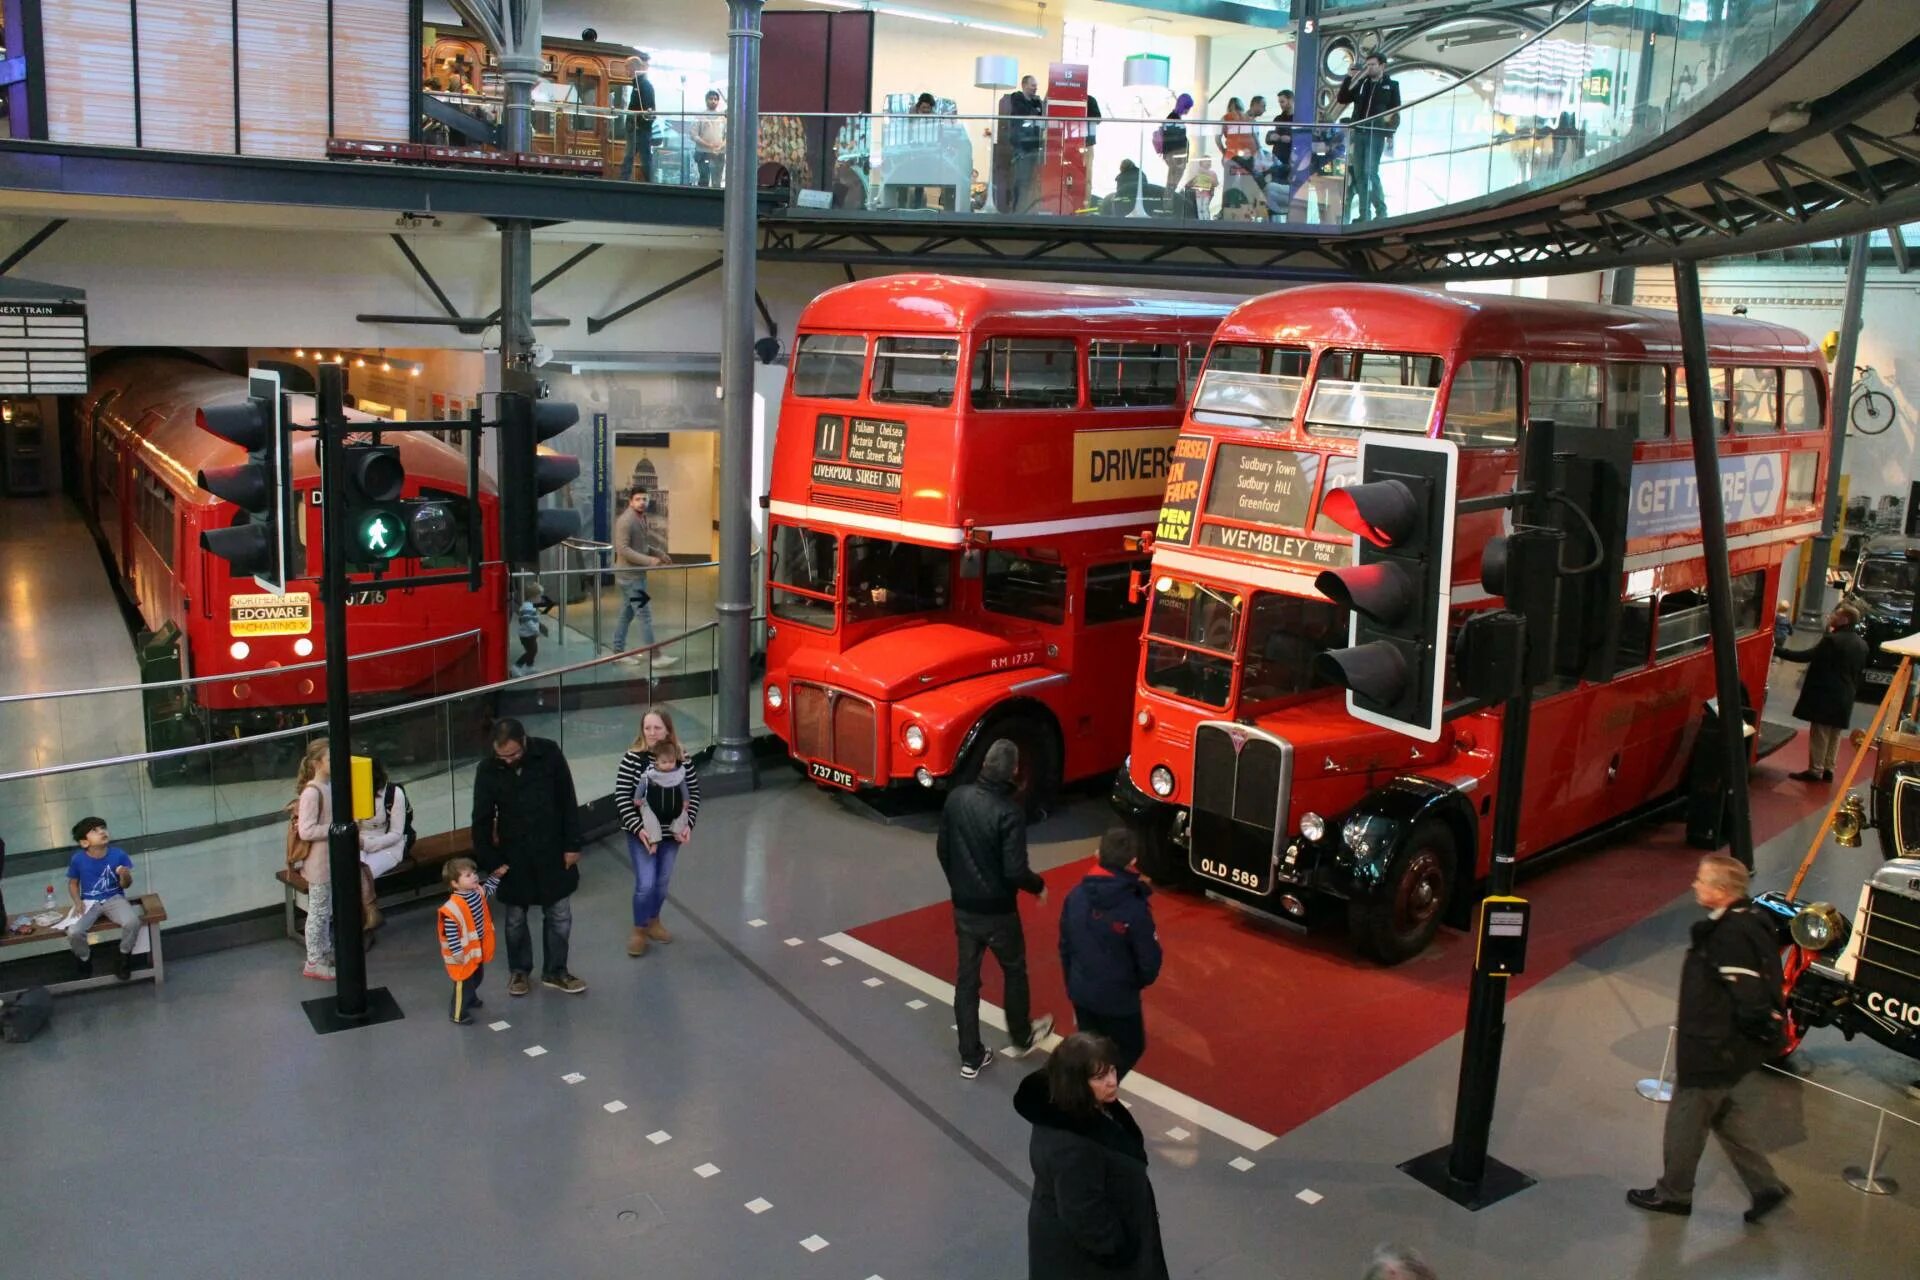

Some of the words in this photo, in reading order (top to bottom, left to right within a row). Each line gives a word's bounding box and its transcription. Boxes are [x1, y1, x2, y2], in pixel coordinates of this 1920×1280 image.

[1303, 20, 1313, 34] 5
[24, 306, 53, 314] TRAIN
[823, 423, 836, 451] 11
[855, 421, 875, 433] Fulham
[880, 423, 903, 437] Chelsea
[852, 434, 873, 447] Victoria
[876, 437, 898, 453] Charing
[849, 446, 865, 459] Fleet
[866, 449, 885, 462] Street
[888, 451, 902, 464] Bank
[1239, 455, 1273, 476] Sudbury
[1275, 460, 1297, 476] Town
[813, 464, 853, 481] LIVERPOOL
[855, 469, 884, 485] STREET
[886, 473, 902, 489] STN
[1237, 475, 1270, 494] Sudbury
[1274, 481, 1291, 496] Hill
[1165, 480, 1199, 503] FAIR
[1638, 479, 1679, 515] GET
[1239, 494, 1281, 513] Greenford
[1221, 527, 1309, 557] WEMBLEY
[1313, 541, 1336, 554] EMPIRE
[1315, 551, 1330, 562] POOL
[237, 606, 304, 620] EDGWARE
[991, 656, 1008, 668] RM
[1012, 652, 1034, 665] 1737
[813, 763, 832, 779] 737
[833, 770, 852, 786] DYE
[1201, 858, 1227, 877] OLD
[1231, 868, 1259, 888] 589
